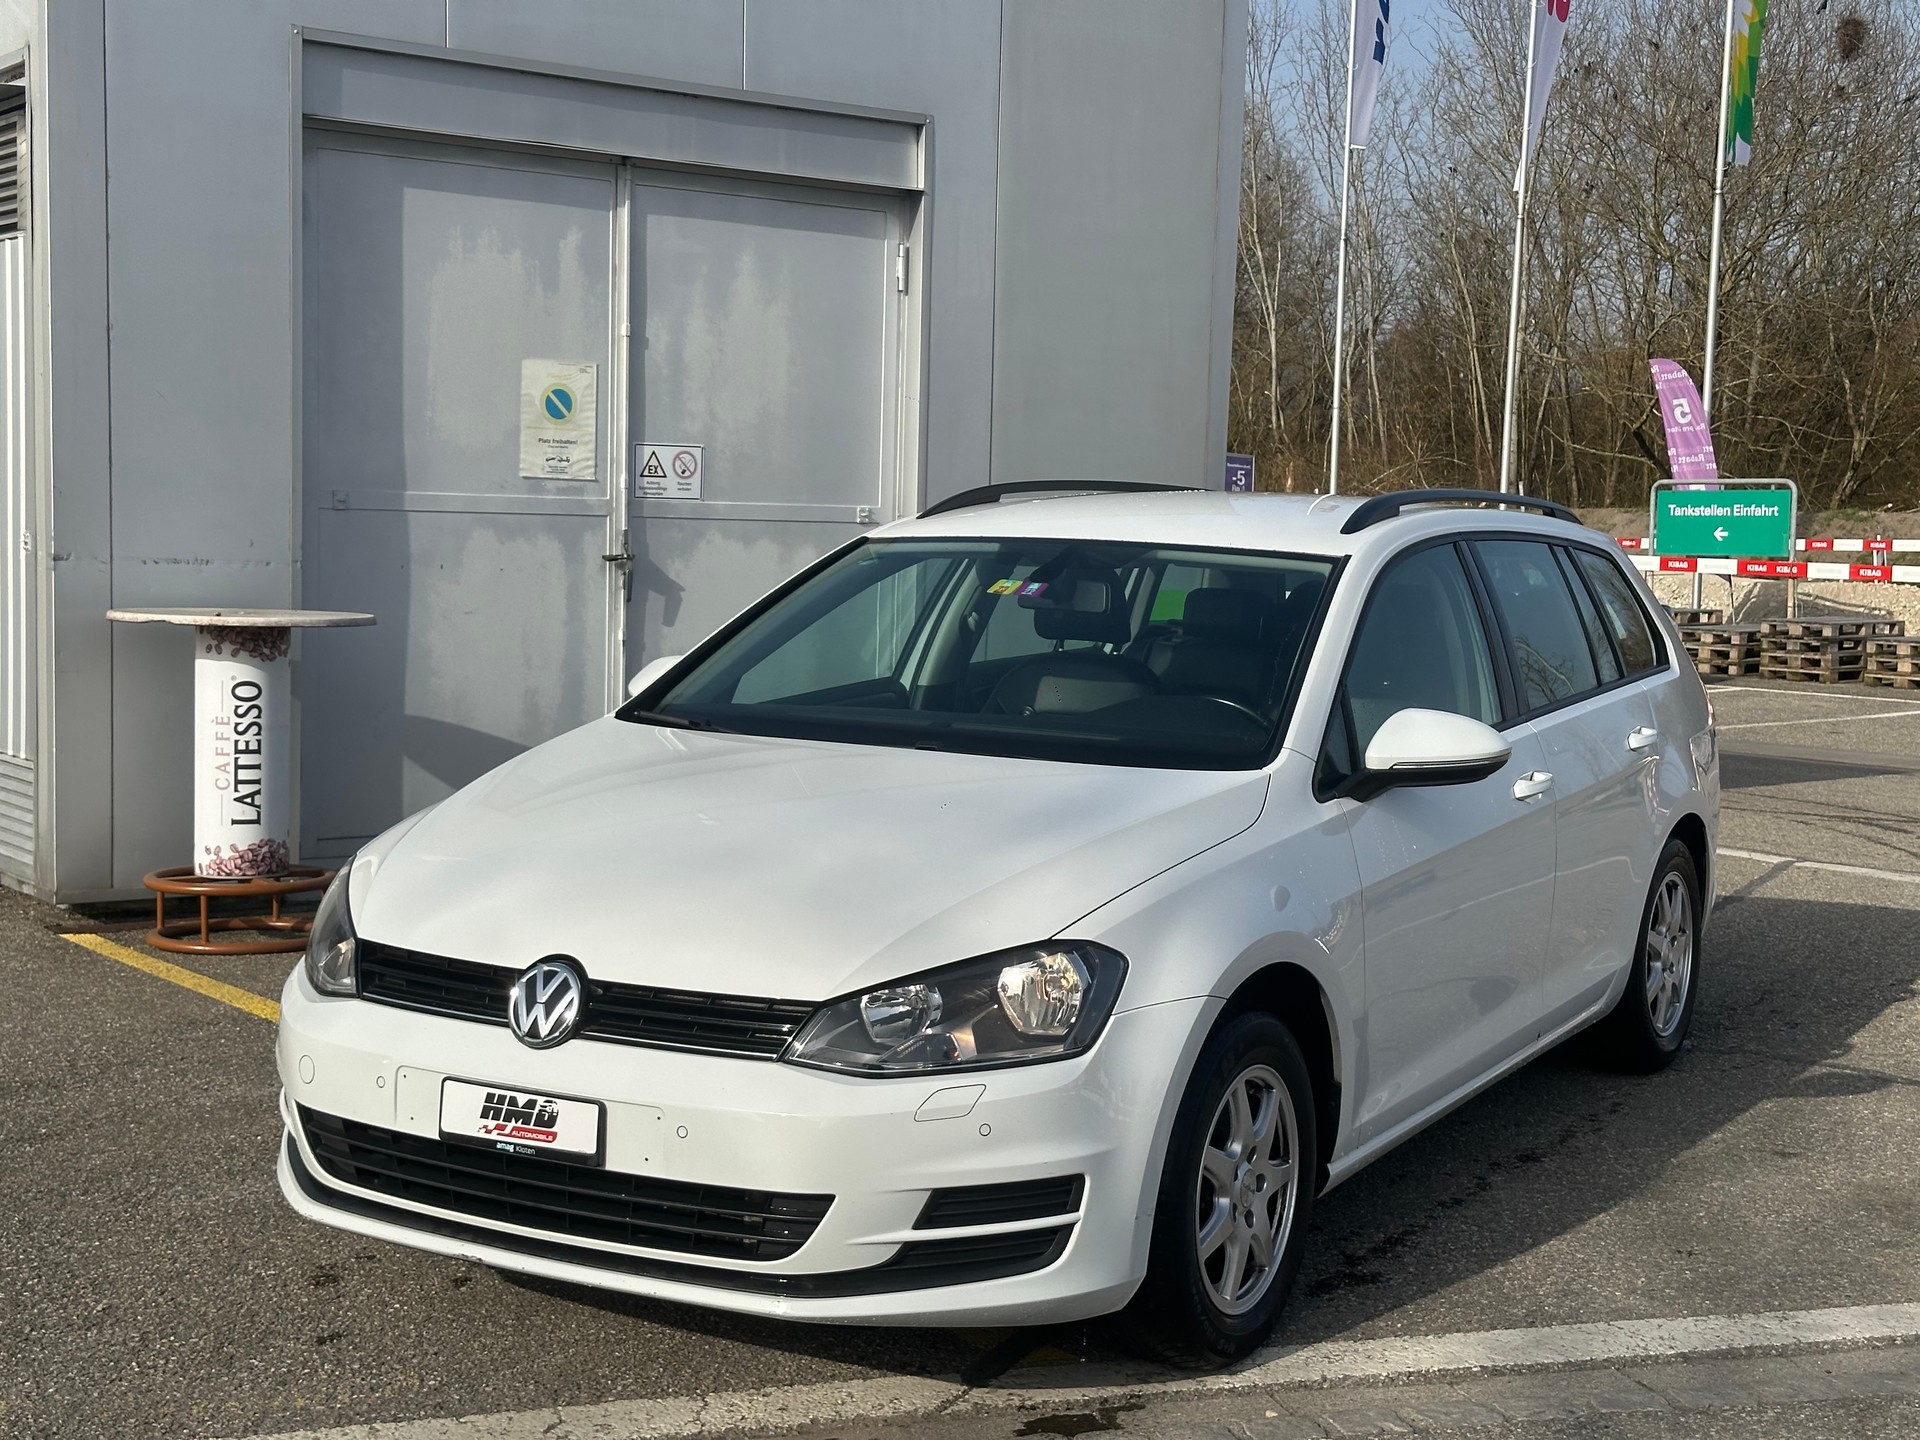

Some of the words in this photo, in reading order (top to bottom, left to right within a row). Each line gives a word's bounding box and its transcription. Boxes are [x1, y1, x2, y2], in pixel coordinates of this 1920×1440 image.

[648, 464, 659, 475] EX
[1668, 504, 1731, 517] Tankstellen
[1733, 504, 1779, 517] Einfahrt
[1668, 561, 1689, 569] KIBAG
[1859, 569, 1882, 577] KIBAG
[231, 680, 263, 826] LATTESSO
[511, 1130, 554, 1141] AUTOMOBILE
[496, 1142, 515, 1153] amag
